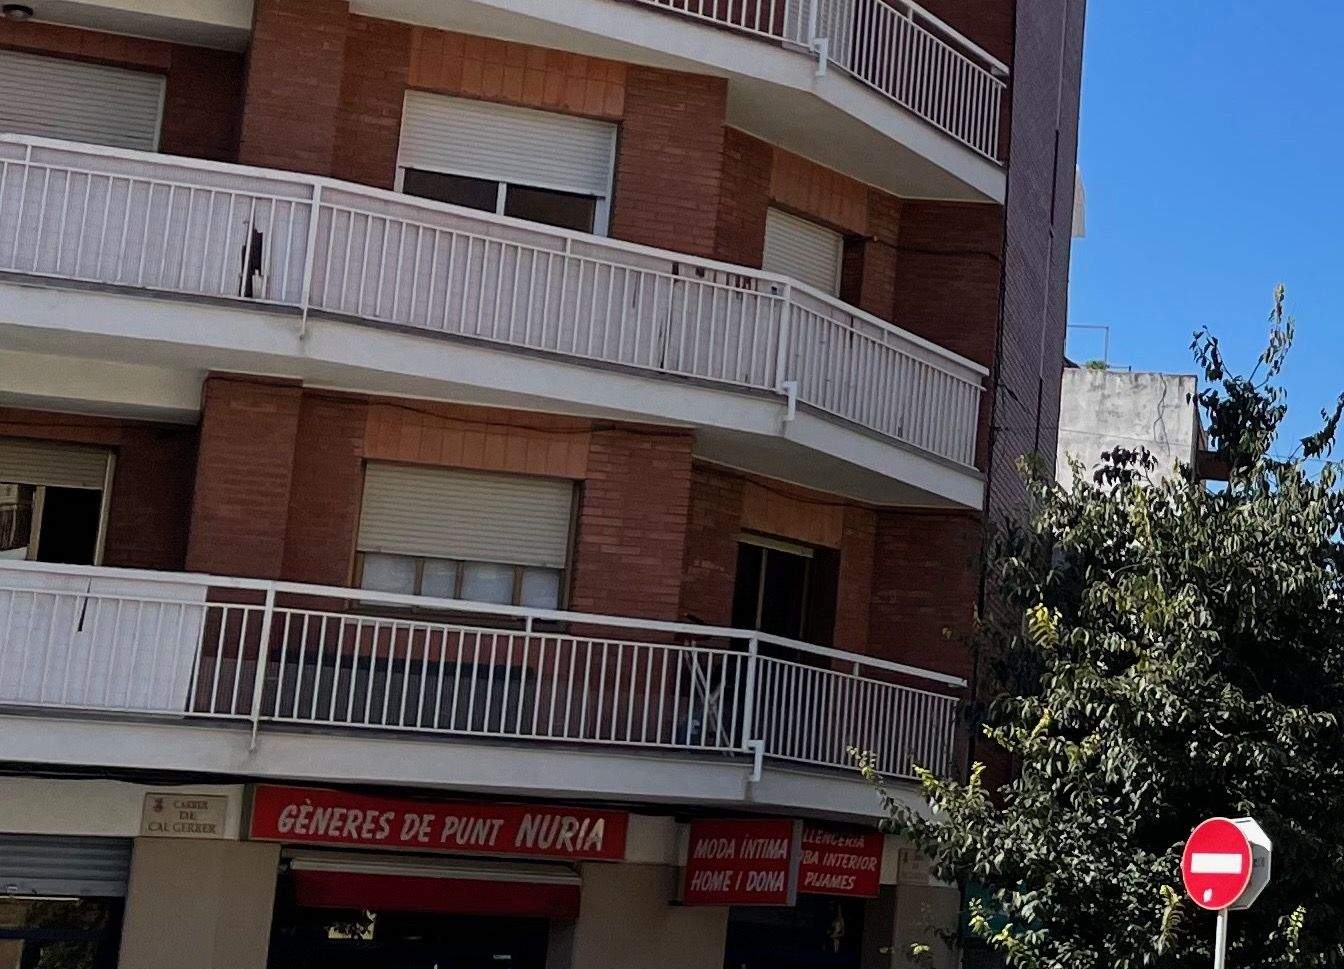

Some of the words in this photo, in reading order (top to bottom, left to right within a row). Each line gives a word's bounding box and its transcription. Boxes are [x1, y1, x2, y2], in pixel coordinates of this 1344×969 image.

[277, 799, 395, 840] GÈNERES
[400, 813, 432, 842] DE
[440, 816, 504, 847] PUNT
[514, 813, 606, 852] NURIA
[693, 838, 735, 859] MODA
[739, 833, 790, 860] ÍNTIMA
[822, 852, 878, 872] INTERIOR
[690, 870, 734, 892] HOME
[735, 872, 742, 892] I
[746, 870, 786, 892] DONA
[804, 872, 857, 890] PIJAMES
